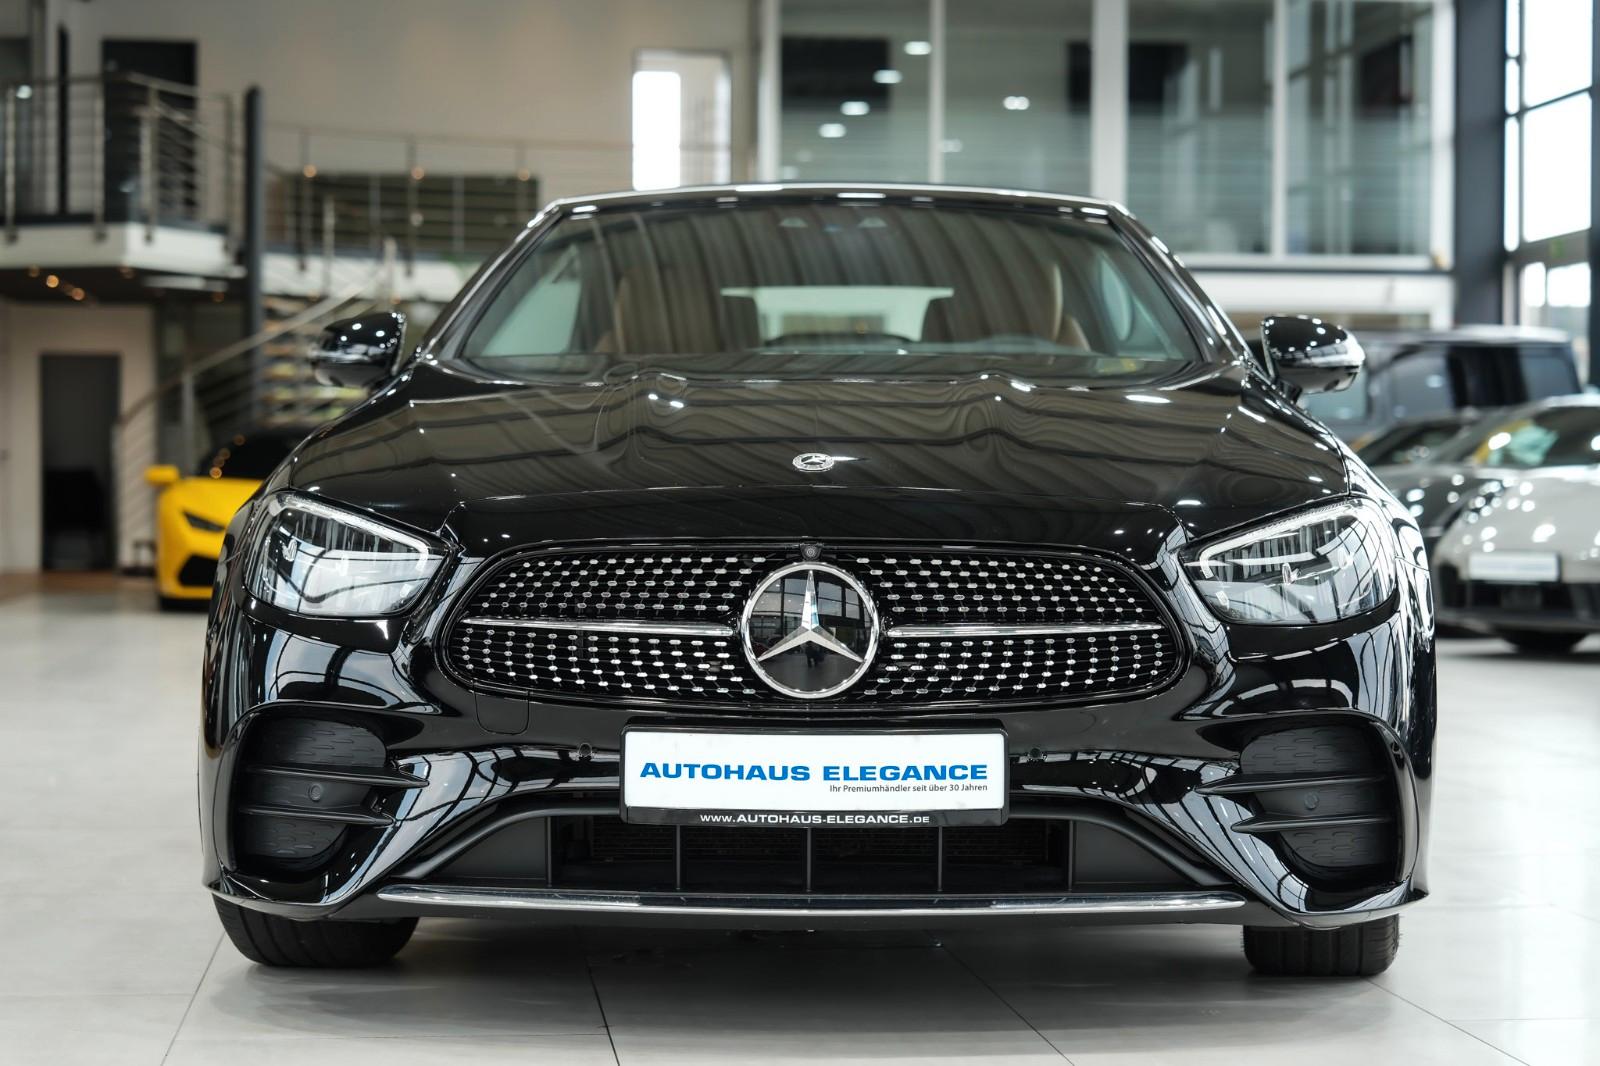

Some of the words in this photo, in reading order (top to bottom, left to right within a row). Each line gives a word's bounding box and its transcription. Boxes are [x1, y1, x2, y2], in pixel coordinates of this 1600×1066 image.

[640, 763, 811, 781] AUTOHAUS
[823, 764, 988, 781] ELEGANCE
[829, 784, 841, 792] Ihr
[843, 784, 910, 793] Premiumhändler
[912, 784, 927, 792] seit
[929, 784, 947, 792] über
[949, 784, 960, 792] 30
[961, 783, 988, 792] Jahren
